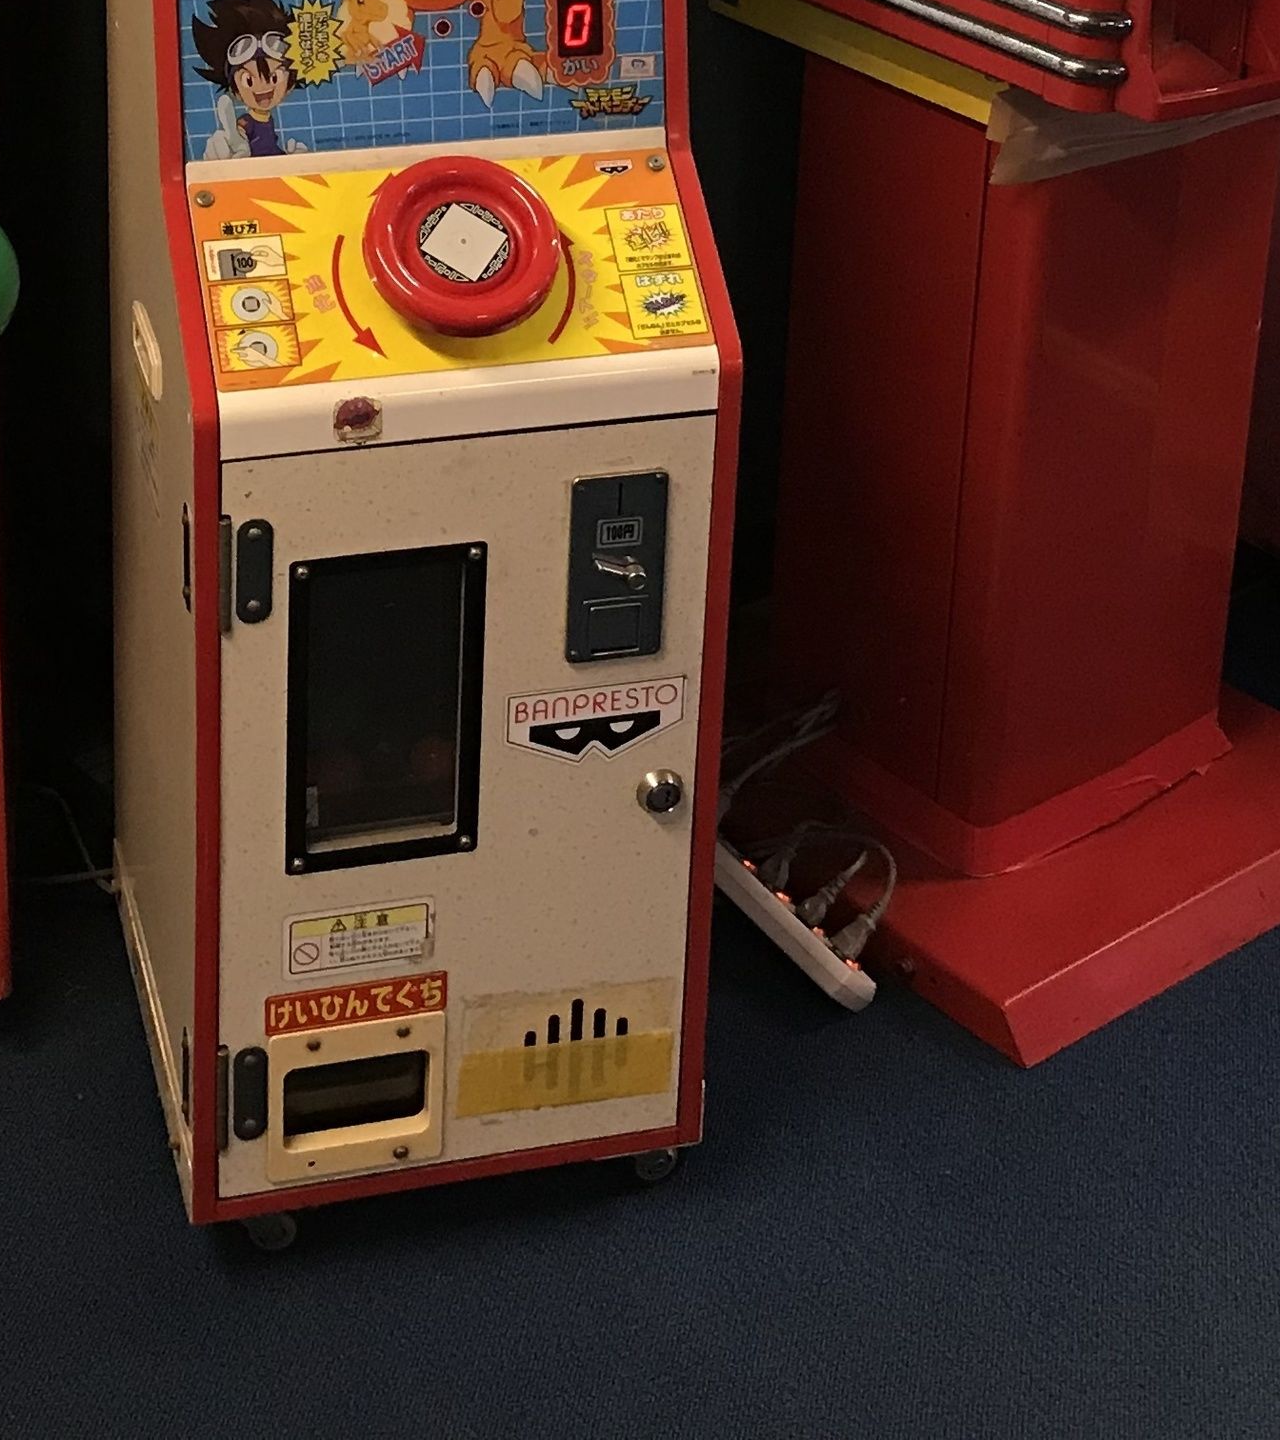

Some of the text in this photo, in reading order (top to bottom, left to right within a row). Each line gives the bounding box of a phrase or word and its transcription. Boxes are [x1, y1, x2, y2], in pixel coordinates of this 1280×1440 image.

[564, 4, 592, 47] 0
[365, 35, 420, 80] START
[620, 208, 666, 222] あたり
[236, 256, 254, 269] 100
[513, 682, 680, 725] BANPRESTO
[269, 979, 444, 1030] けいひんでぐち
